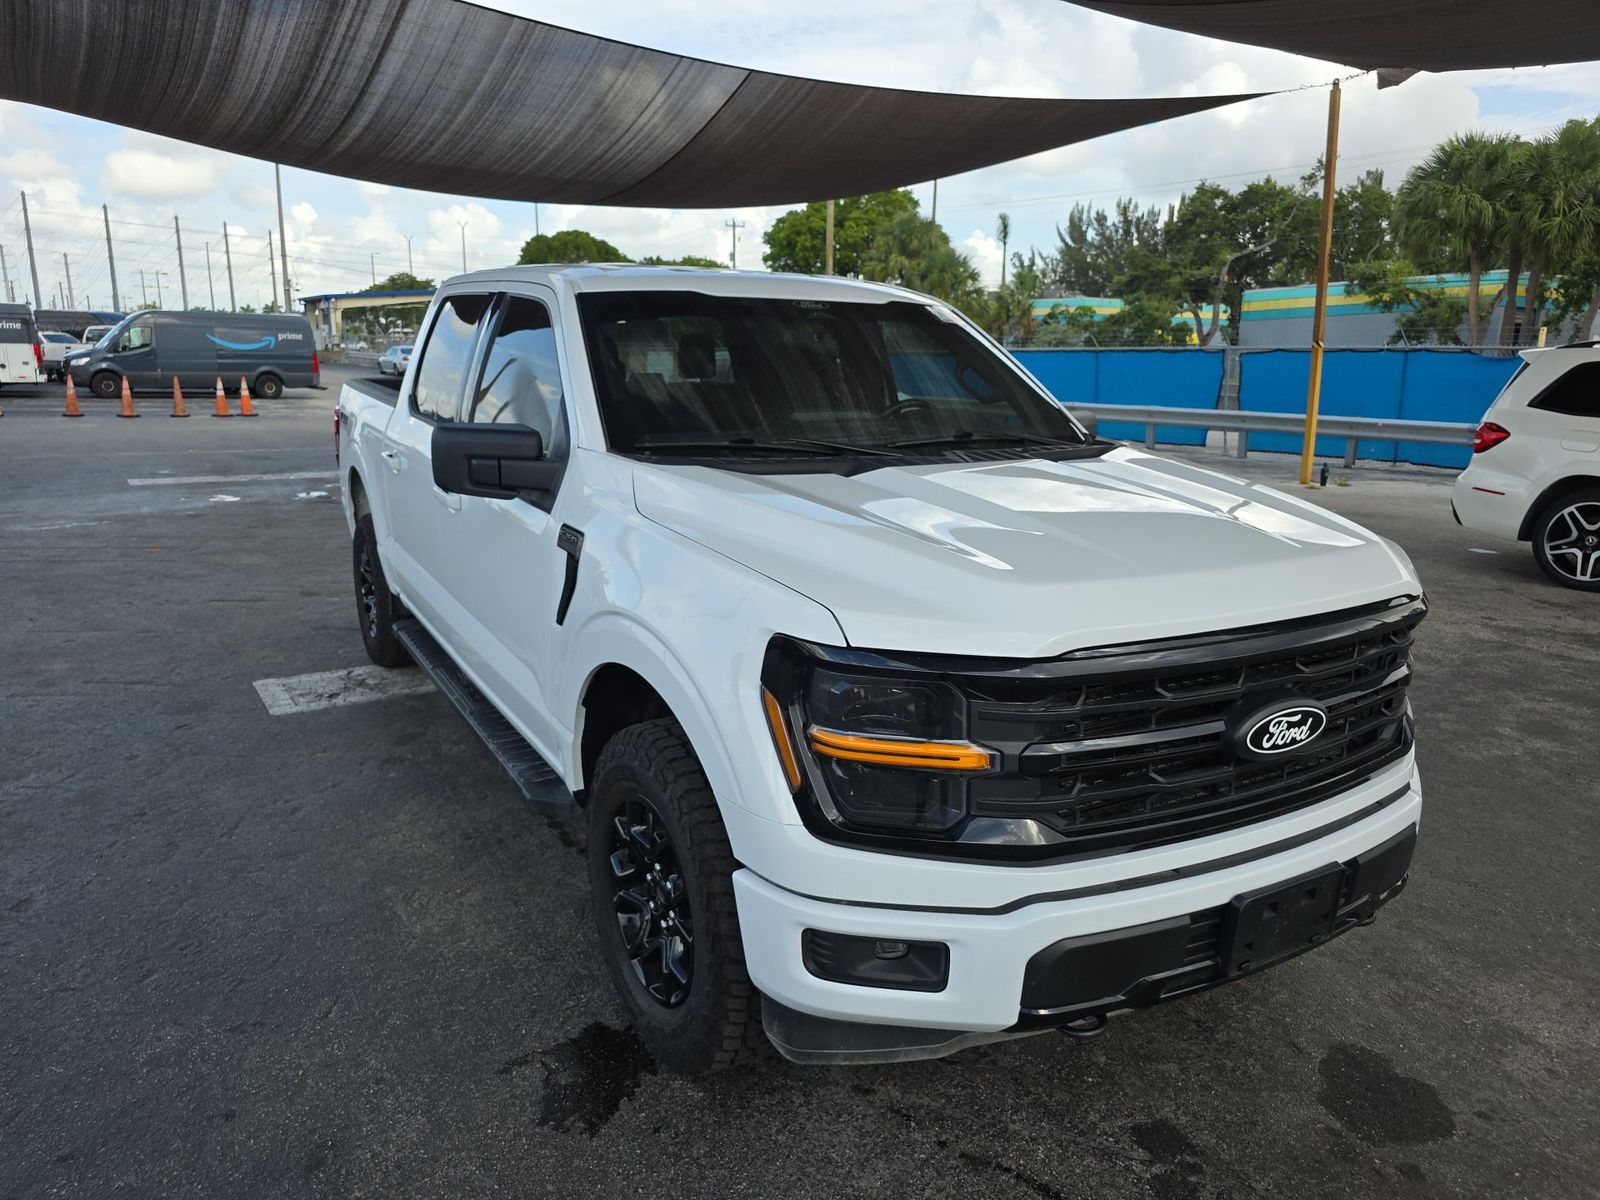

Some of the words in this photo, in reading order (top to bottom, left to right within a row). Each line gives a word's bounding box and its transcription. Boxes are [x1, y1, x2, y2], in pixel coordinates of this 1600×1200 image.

[0, 320, 22, 329] rime
[278, 331, 303, 341] prime
[1262, 714, 1313, 748] Ford
